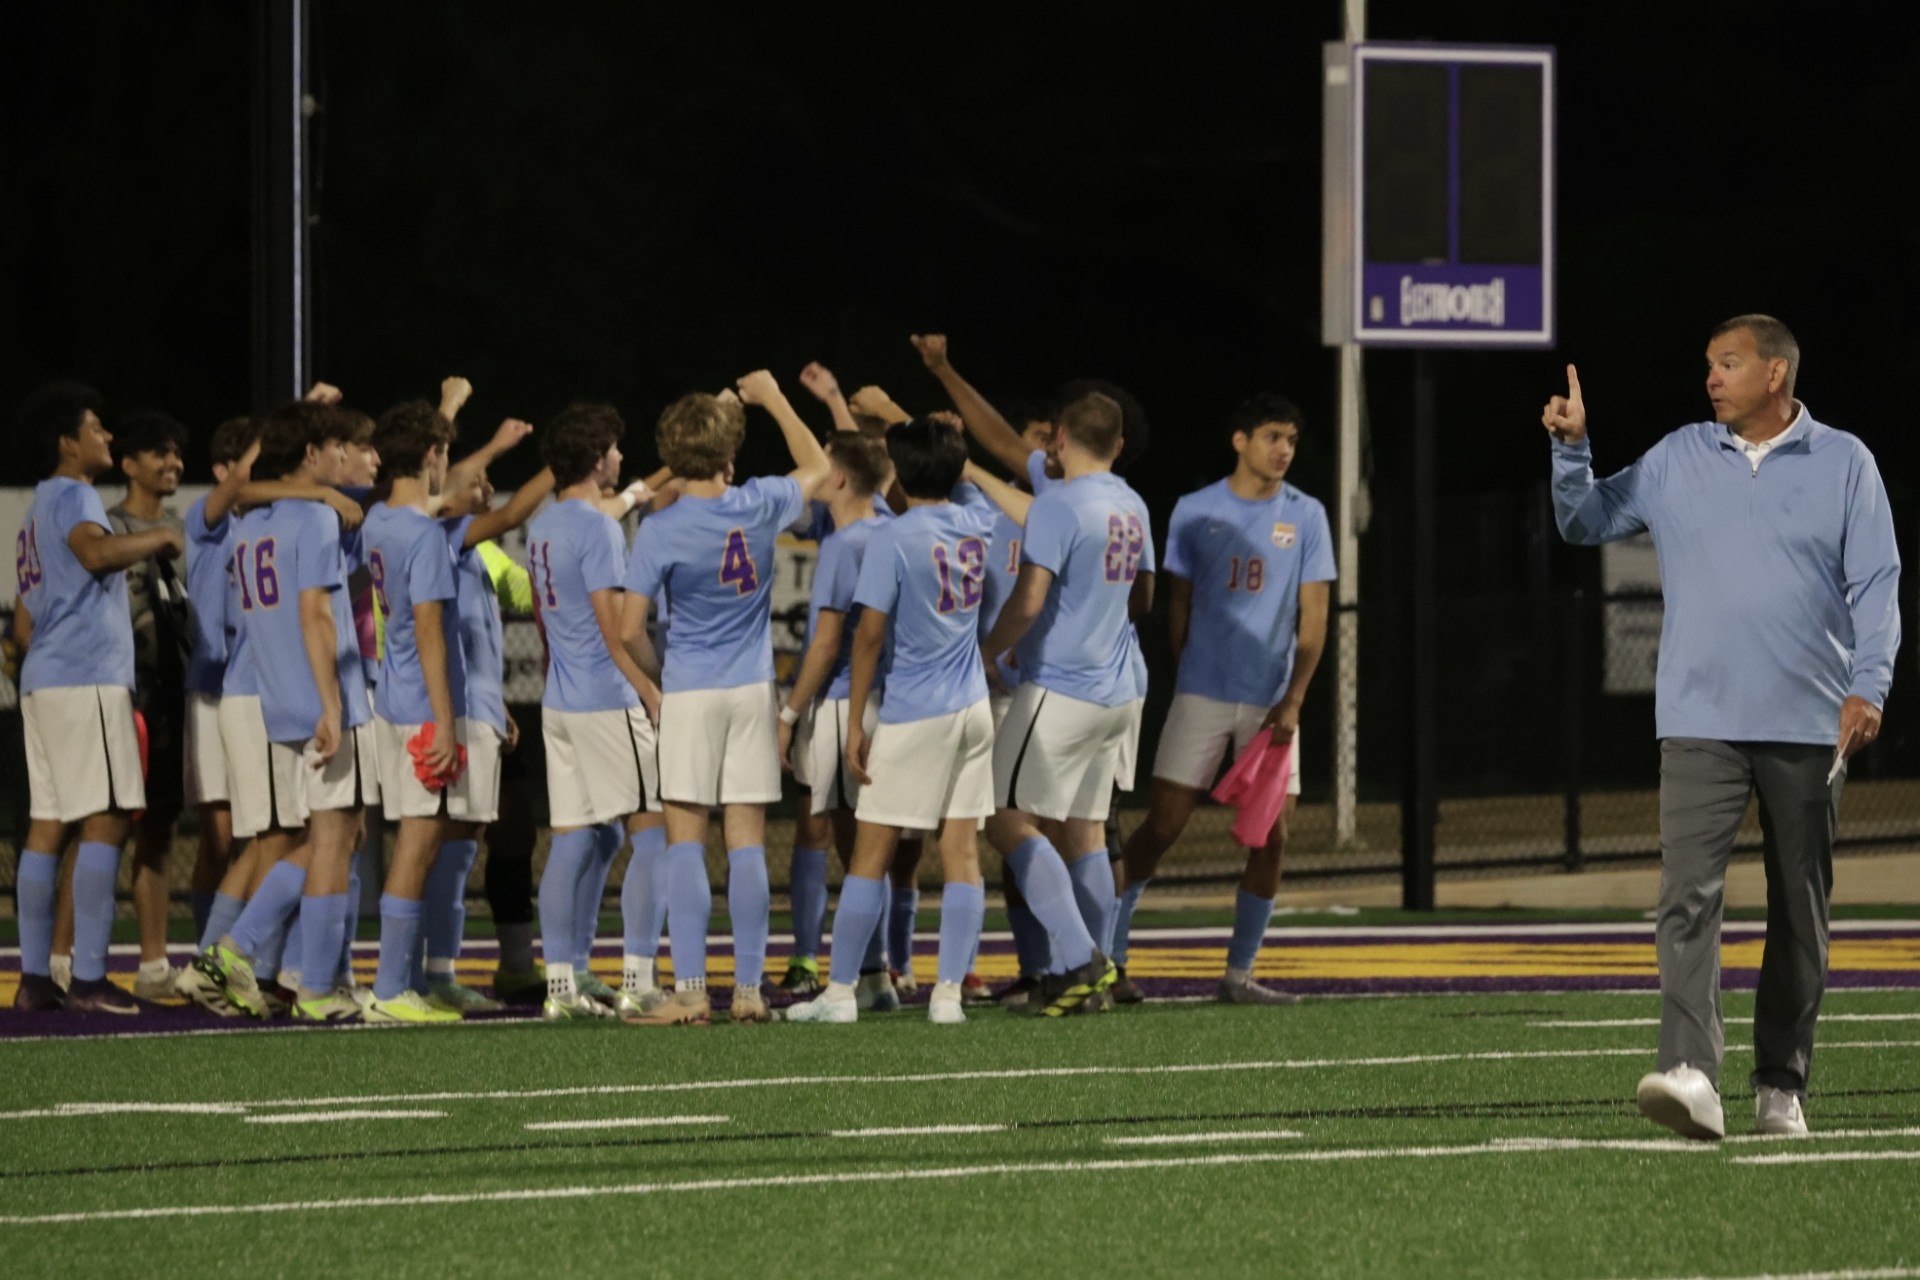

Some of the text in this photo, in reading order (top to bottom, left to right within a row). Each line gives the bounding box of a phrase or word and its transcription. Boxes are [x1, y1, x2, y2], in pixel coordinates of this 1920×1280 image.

[16, 517, 43, 596] 20
[235, 535, 281, 612] 16
[719, 526, 759, 596] 4
[931, 536, 987, 614] 12
[1105, 512, 1144, 584] 22
[1227, 556, 1265, 593] 18
